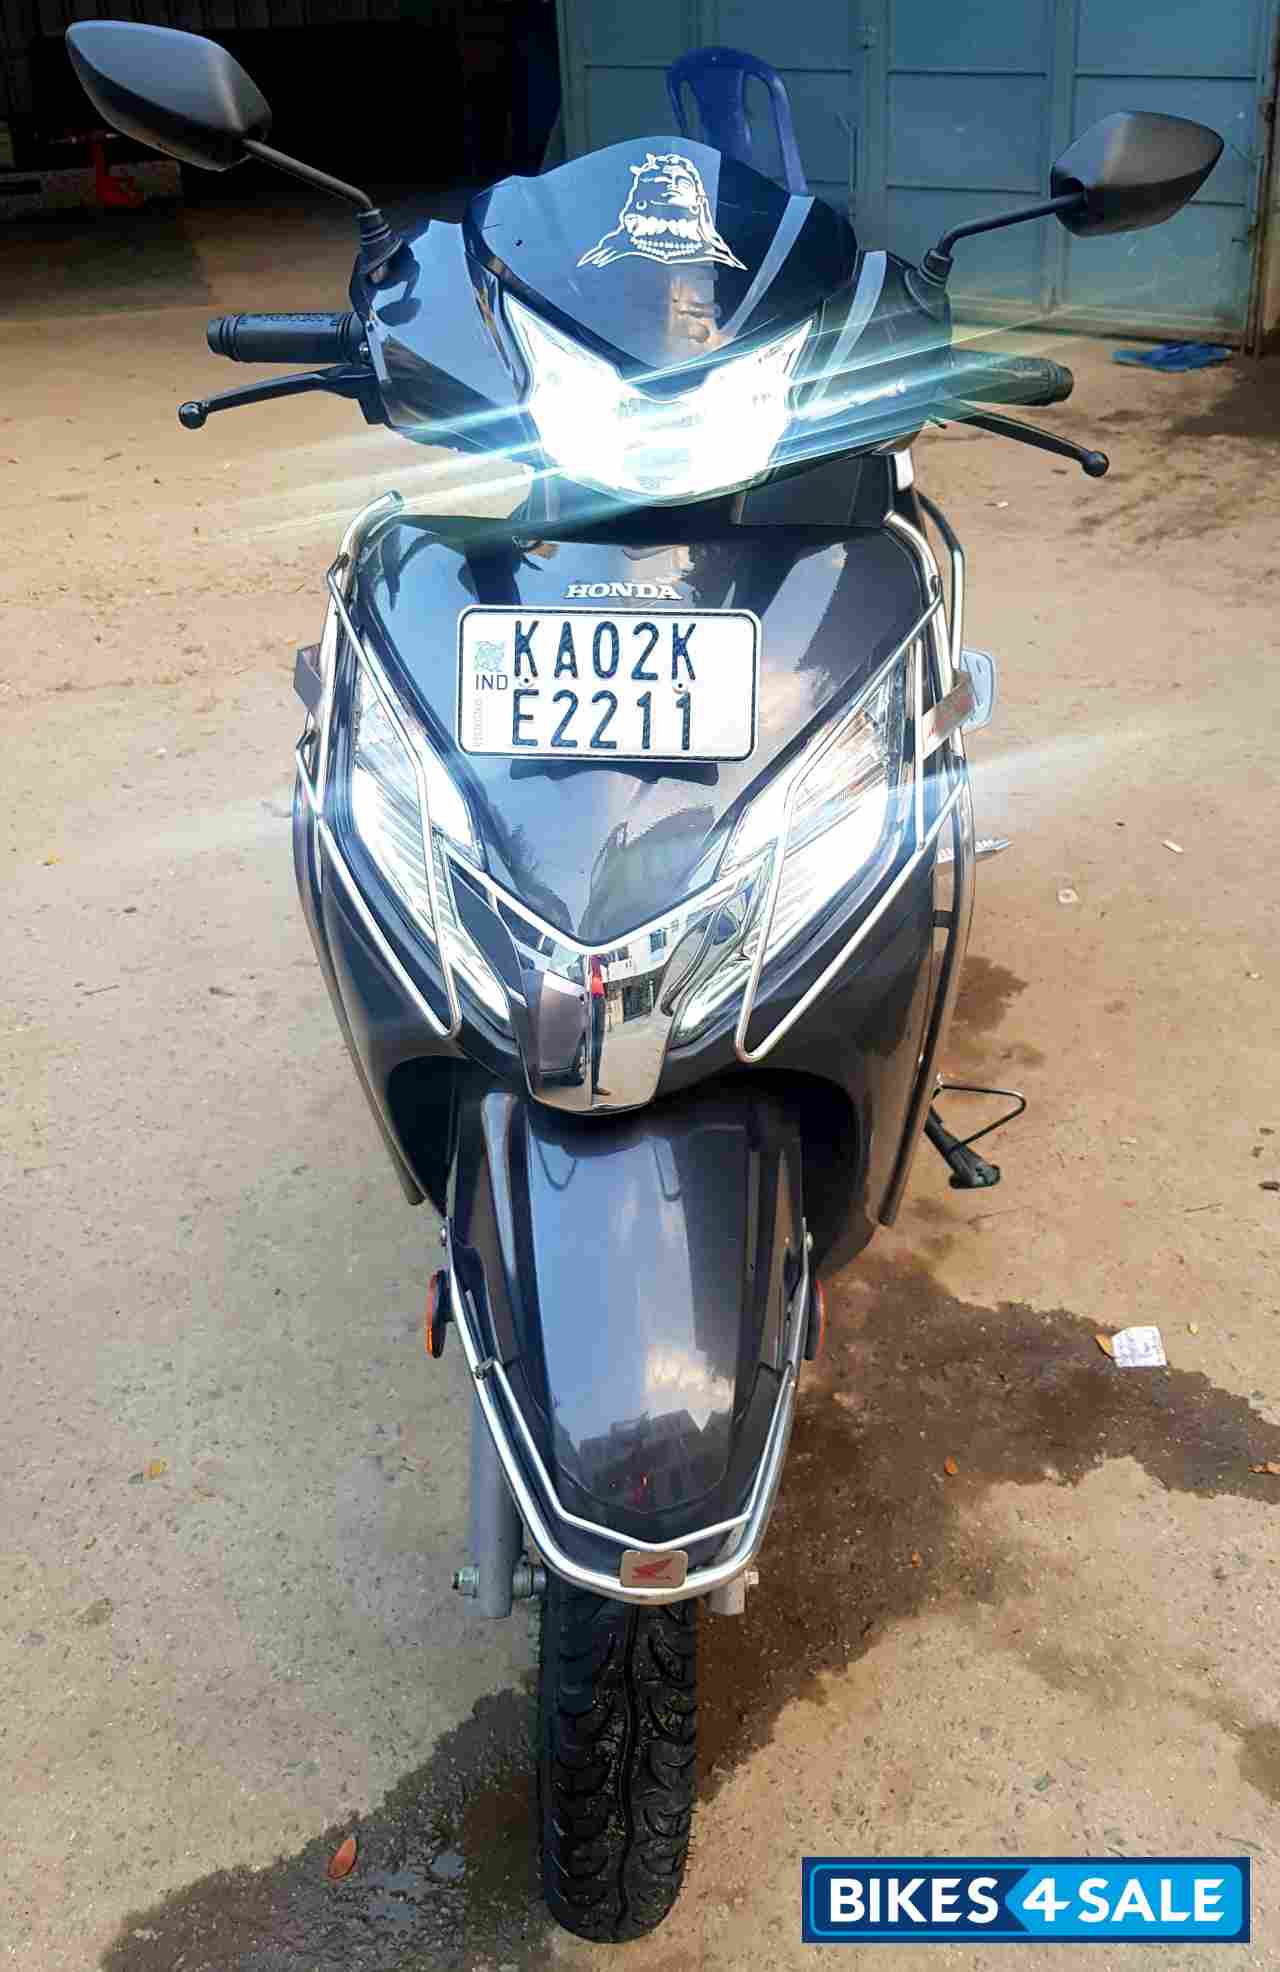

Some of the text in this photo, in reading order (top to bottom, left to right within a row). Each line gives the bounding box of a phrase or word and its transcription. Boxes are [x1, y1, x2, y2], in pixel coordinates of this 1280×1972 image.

[563, 582, 683, 600] HONDA
[513, 620, 697, 681] KA02K
[475, 674, 509, 690] IND
[511, 688, 691, 750] E2211
